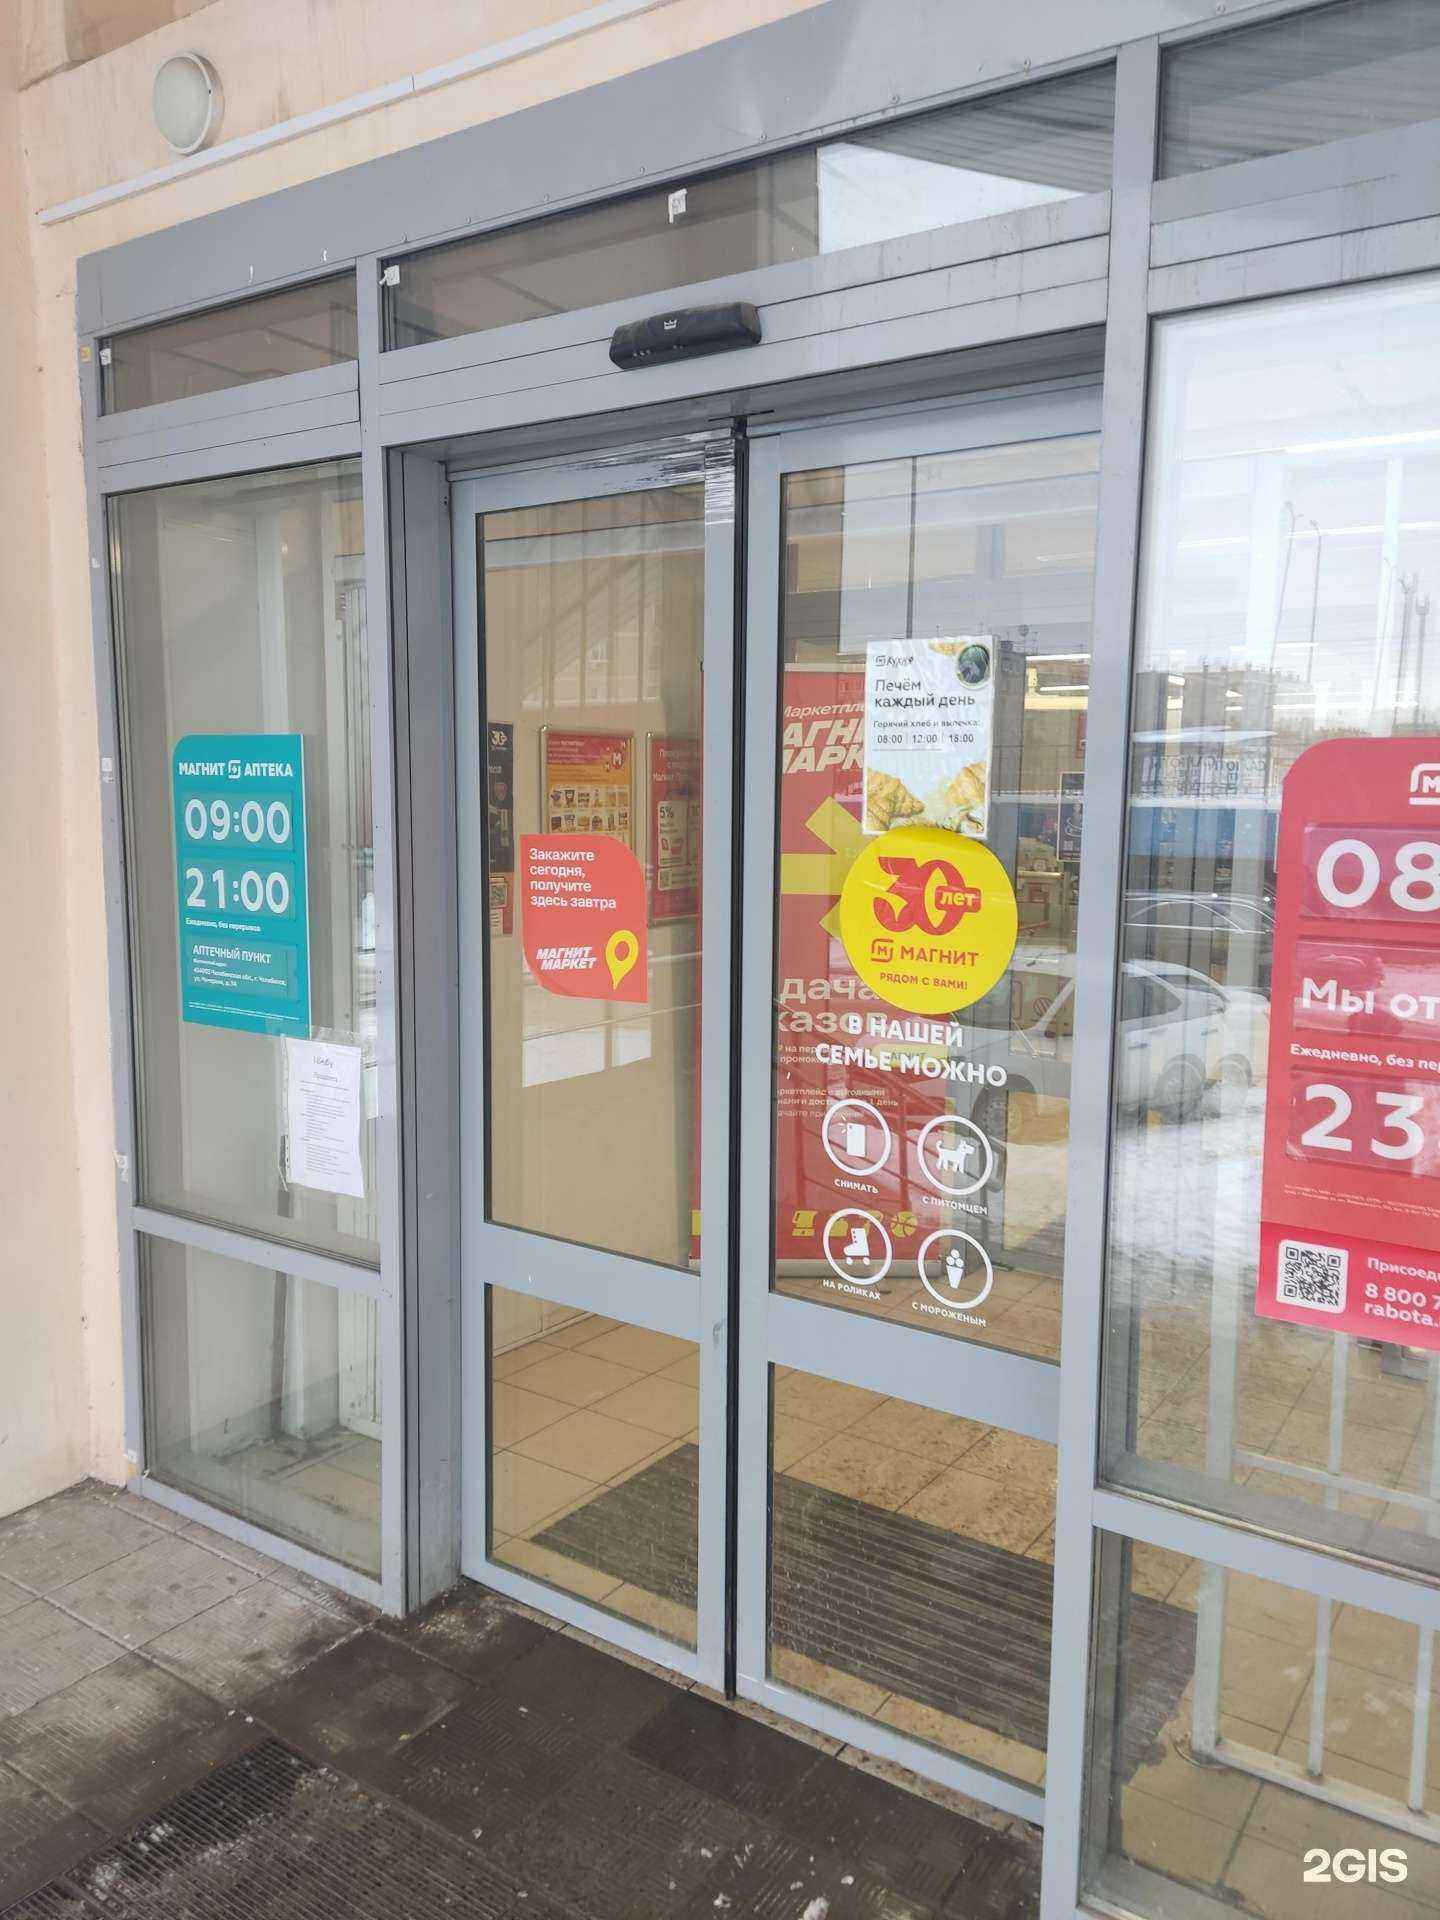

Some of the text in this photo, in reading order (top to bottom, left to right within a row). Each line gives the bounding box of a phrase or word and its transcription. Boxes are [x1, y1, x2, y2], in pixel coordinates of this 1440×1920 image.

[875, 678, 921, 692] Печём
[875, 693, 976, 709] каждый день
[911, 719, 931, 728] хлеб
[912, 734, 938, 744] 12:00
[178, 762, 294, 778] МАГНИТ АПТЕКА
[184, 799, 291, 844] 09:00
[529, 848, 595, 862] Закажите
[529, 864, 586, 878] сегодня,
[1316, 838, 1440, 912] 08
[185, 867, 290, 914] 21:00
[529, 879, 592, 894] получите
[872, 856, 968, 936] 30
[530, 895, 617, 910] здесь завтра
[940, 890, 980, 908] лет
[193, 944, 240, 960] АПТЕЧНЫЙ
[241, 950, 272, 964] ПУНКТ
[536, 946, 592, 960] МАГНИТ
[900, 945, 980, 967] МАГНИТ
[540, 957, 597, 970] МАРКЕТ
[880, 972, 968, 991] РЯДОМ С ВАМИ!
[1302, 977, 1375, 1015] Мы
[870, 1015, 963, 1048] НАШЕЙ
[815, 1043, 1008, 1087] СЕМЬЕ МОЖНО
[1290, 1043, 1383, 1066] Ежедневно,
[1386, 1054, 1414, 1069] без
[1301, 1083, 1426, 1160] 23
[834, 1178, 880, 1194] СНИМАТЬ
[922, 1196, 989, 1216] С ПИТОМЦЕМ
[822, 1279, 882, 1300] НА РОЛИКАХ
[1364, 1282, 1379, 1299] 8
[1384, 1286, 1427, 1309] 800
[911, 1302, 987, 1328] С МОРОЖЕНЫМ
